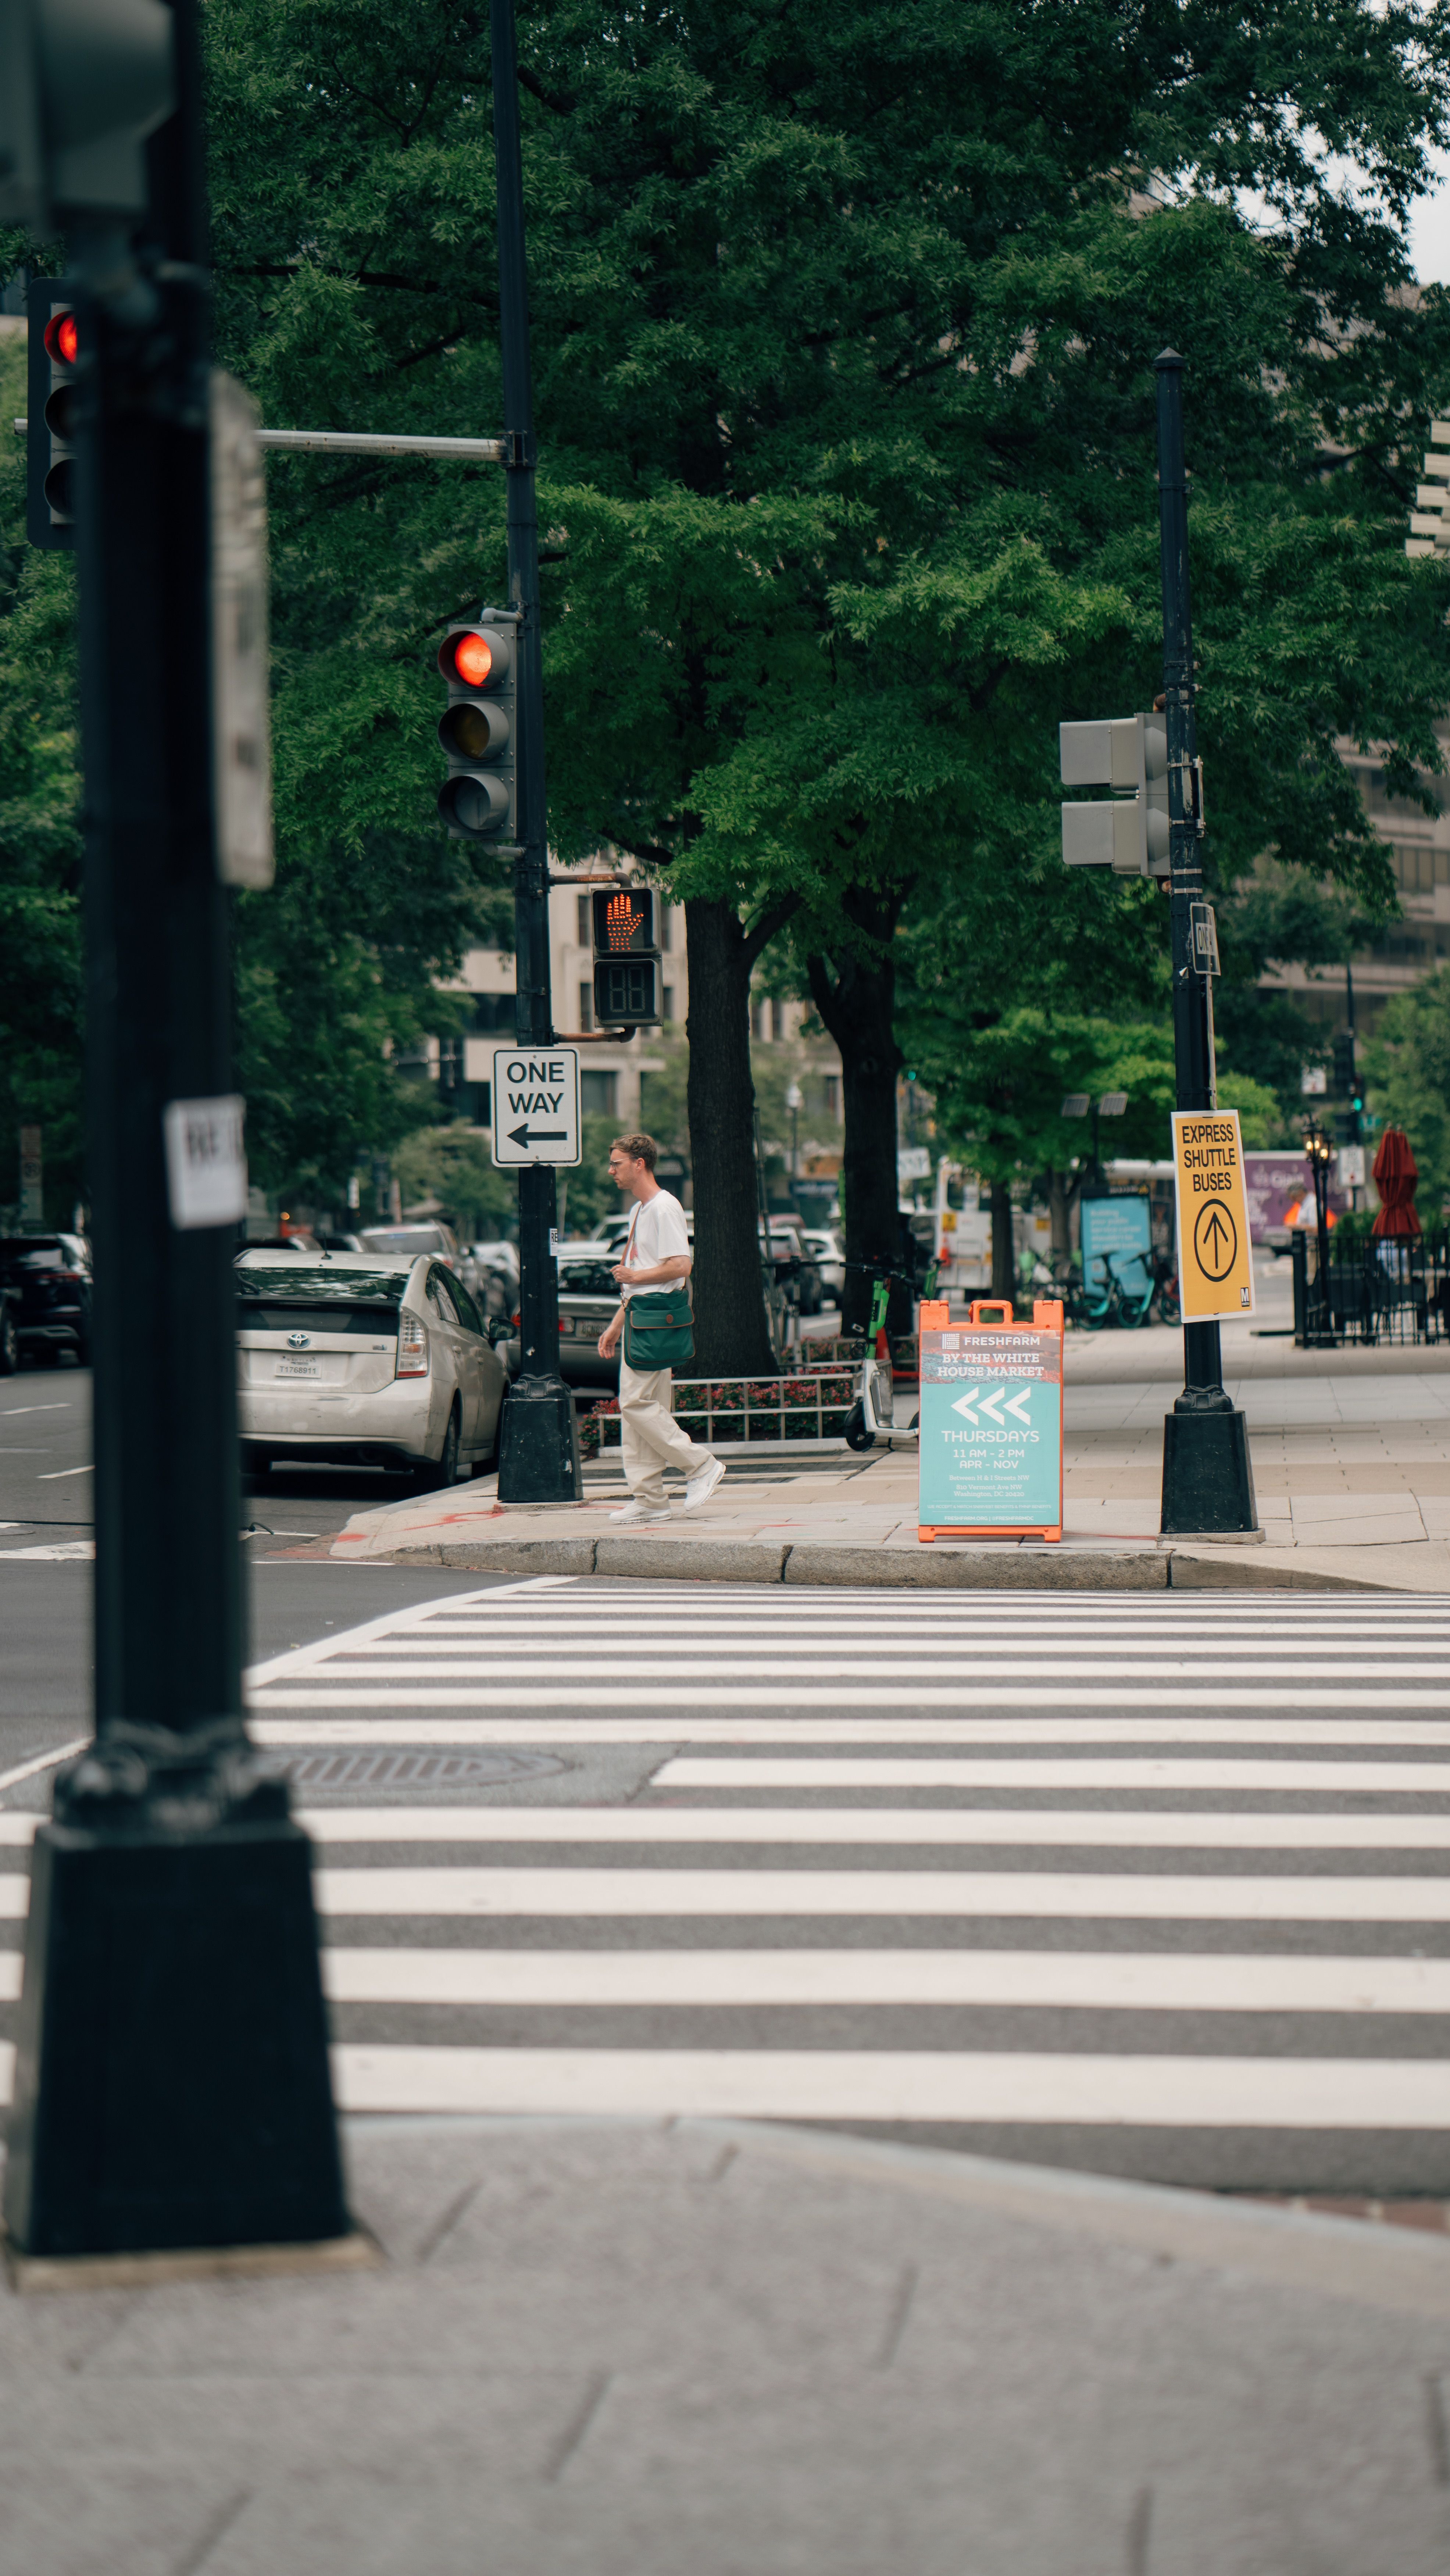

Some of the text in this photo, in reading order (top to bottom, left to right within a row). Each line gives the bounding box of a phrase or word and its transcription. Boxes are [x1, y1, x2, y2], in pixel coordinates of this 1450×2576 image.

[507, 1062, 565, 1083] ONE
[508, 1093, 564, 1113] WAY
[1182, 1124, 1234, 1144] EXPRESS
[1184, 1148, 1236, 1168] SHUTTLE
[1193, 1172, 1232, 1192] BUSES
[1241, 1288, 1249, 1302] M
[964, 1337, 1040, 1345] FRESHFARM
[942, 1353, 1039, 1363] BY THE WHITE
[280, 1366, 316, 1374] T1768911
[938, 1366, 1044, 1376] HOUSE MARKET
[941, 1431, 1039, 1442] THURSDAYS
[953, 1449, 966, 1457] 11
[969, 1449, 986, 1457] AM
[960, 1460, 982, 1468] APR
[994, 1460, 1019, 1468] NOV
